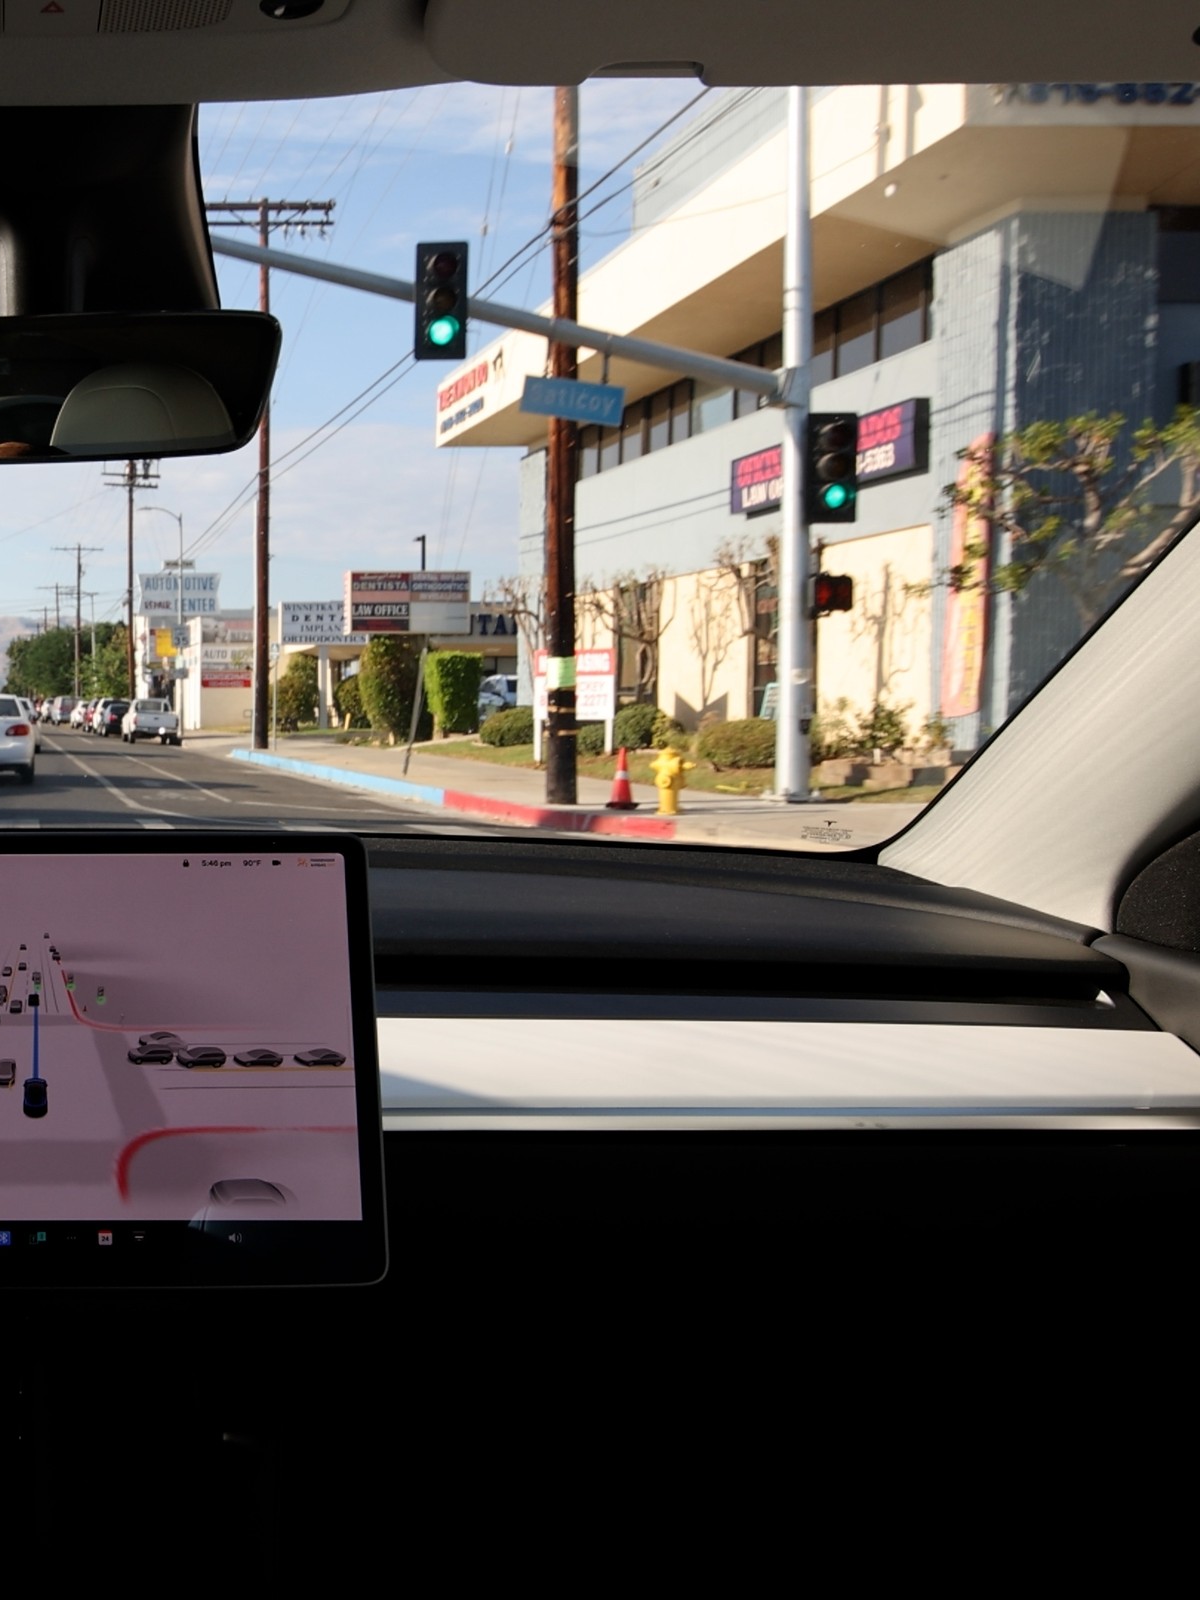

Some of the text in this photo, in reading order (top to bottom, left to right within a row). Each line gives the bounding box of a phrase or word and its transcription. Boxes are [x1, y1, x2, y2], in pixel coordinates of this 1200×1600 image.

[353, 582, 407, 591] DENTISTA
[174, 598, 216, 612] CENTER
[283, 603, 333, 611] WINNETKA
[353, 604, 373, 616] LAW
[374, 604, 408, 616] OFFICE
[300, 624, 343, 632] IMPLAN
[204, 649, 228, 660] AUTO
